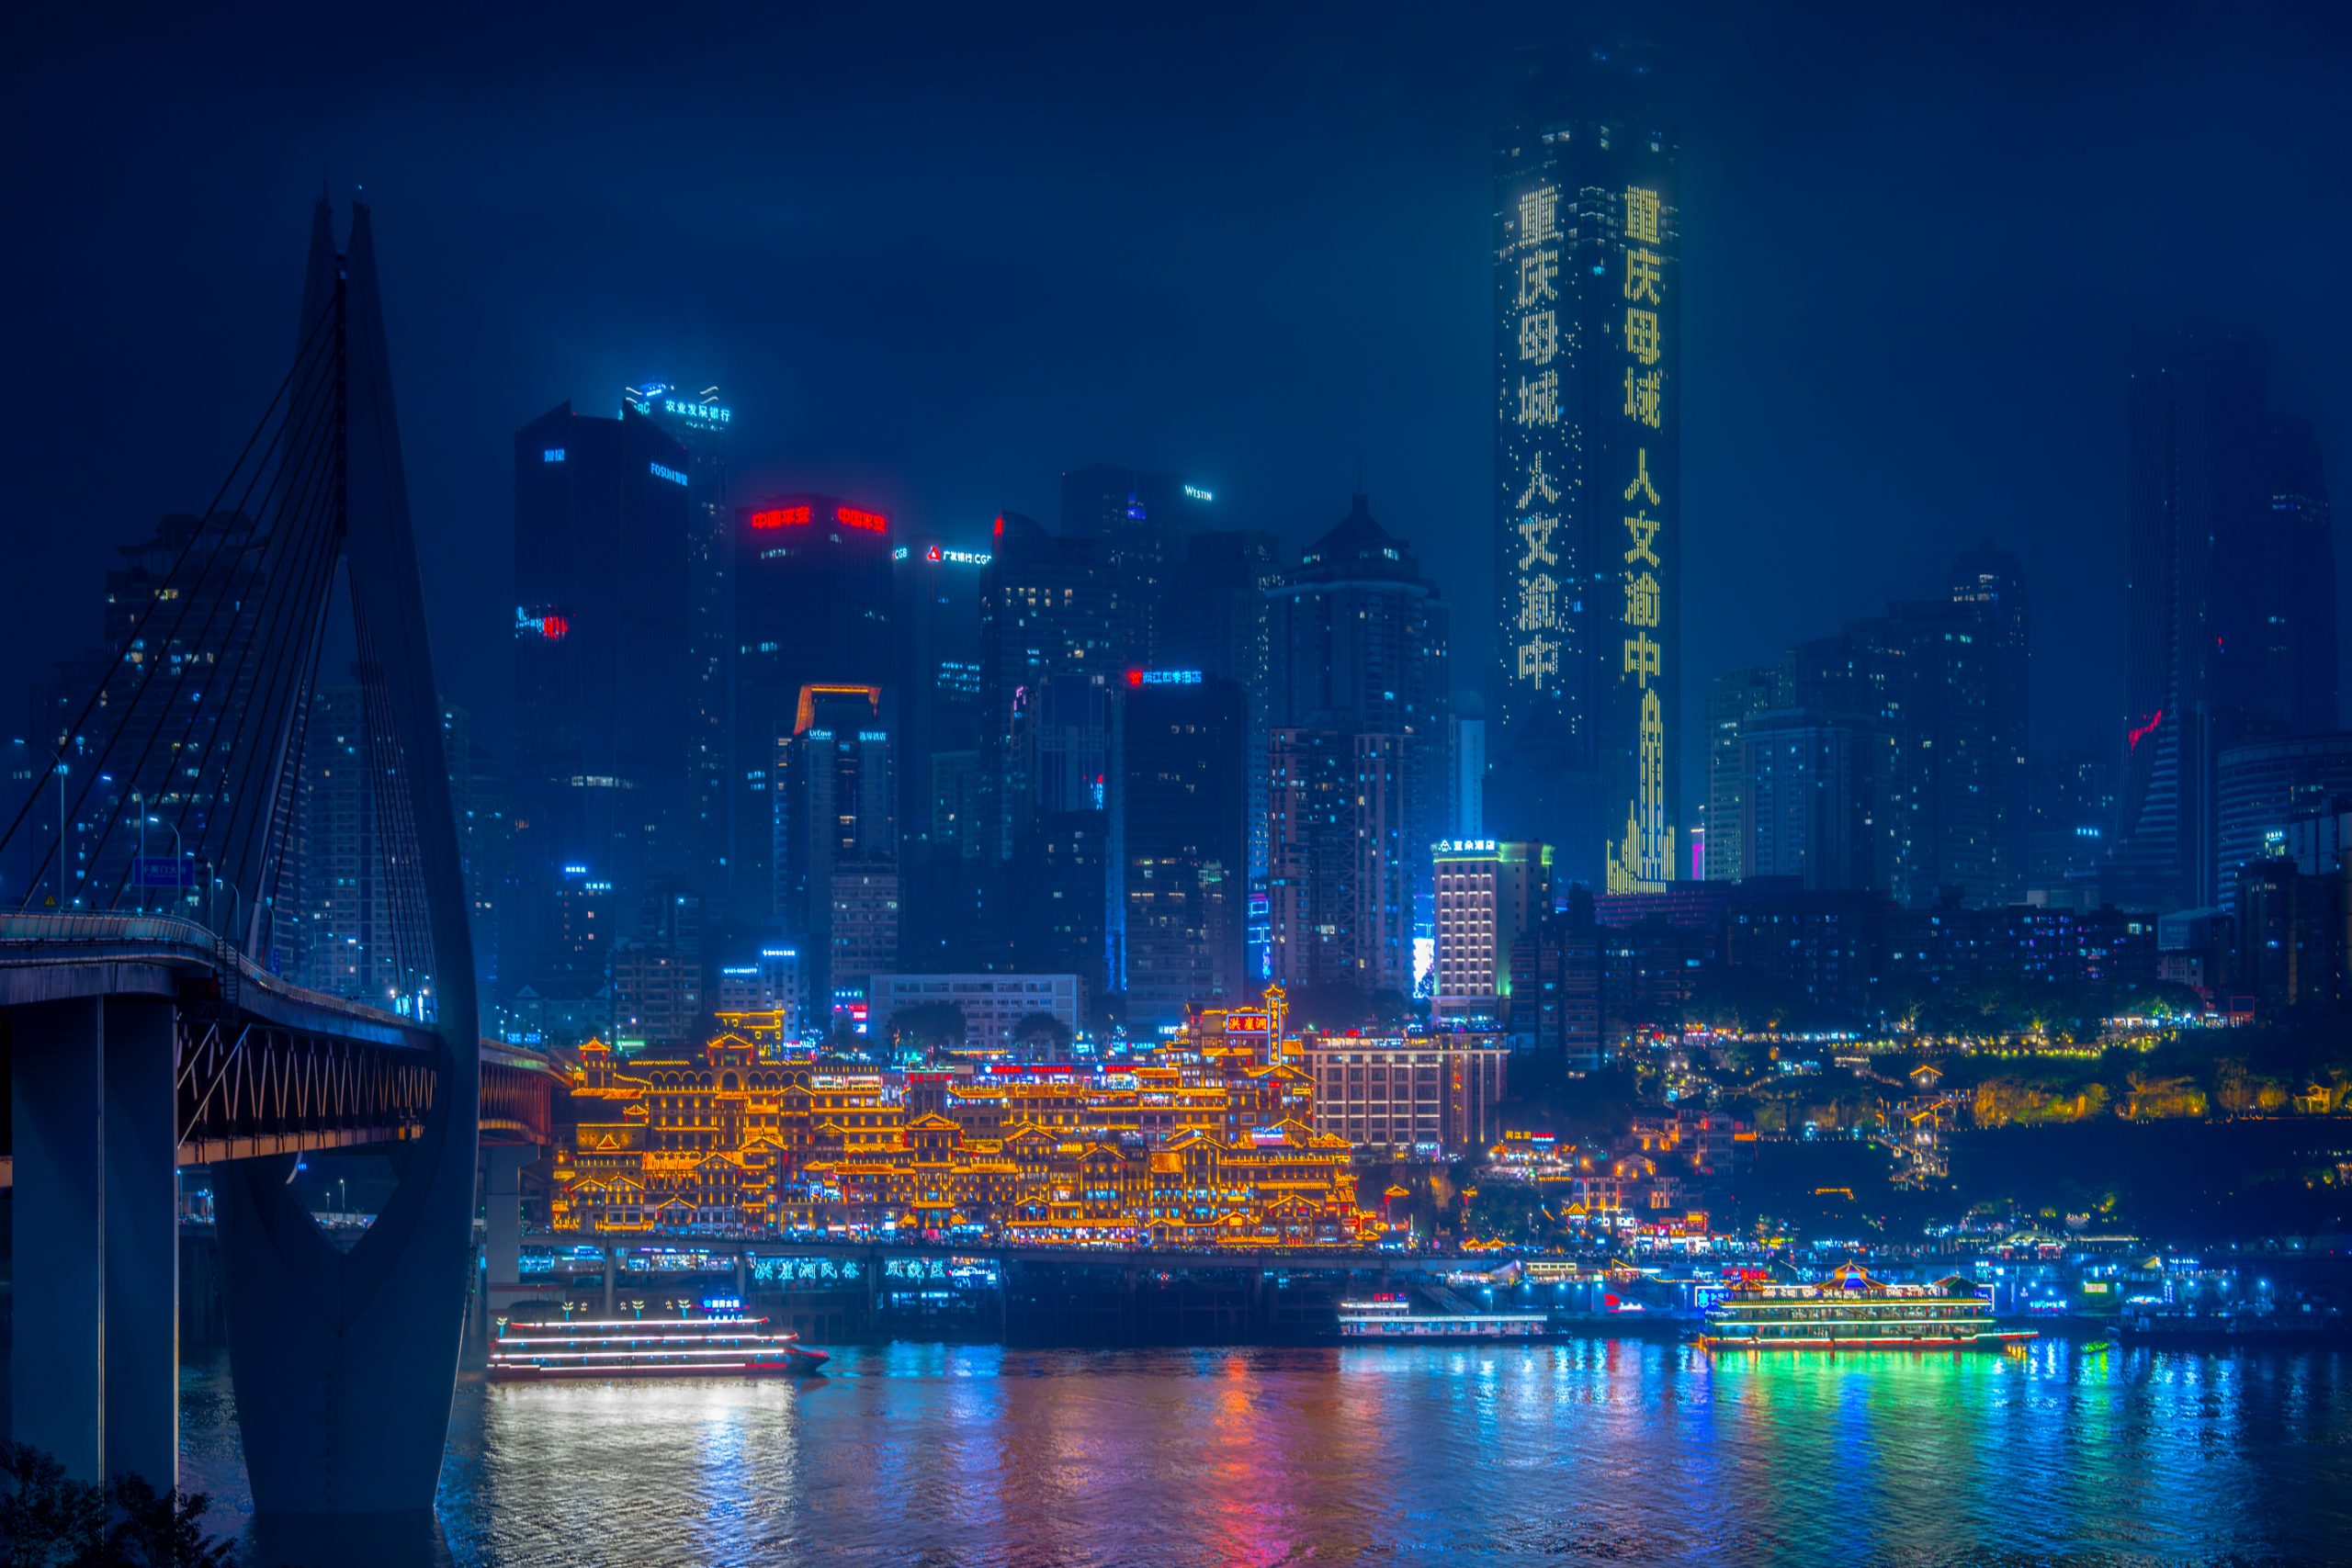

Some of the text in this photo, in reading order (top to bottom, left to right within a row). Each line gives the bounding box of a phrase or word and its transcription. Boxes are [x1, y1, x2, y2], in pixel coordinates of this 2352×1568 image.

[665, 400, 730, 423] 农业发展银行
[752, 506, 809, 529] 中国平安
[838, 507, 886, 534] 中国平安
[895, 547, 907, 559] CGB
[1453, 840, 1494, 852] 亚朵酒店
[1228, 1016, 1267, 1031] 洪崖洞
